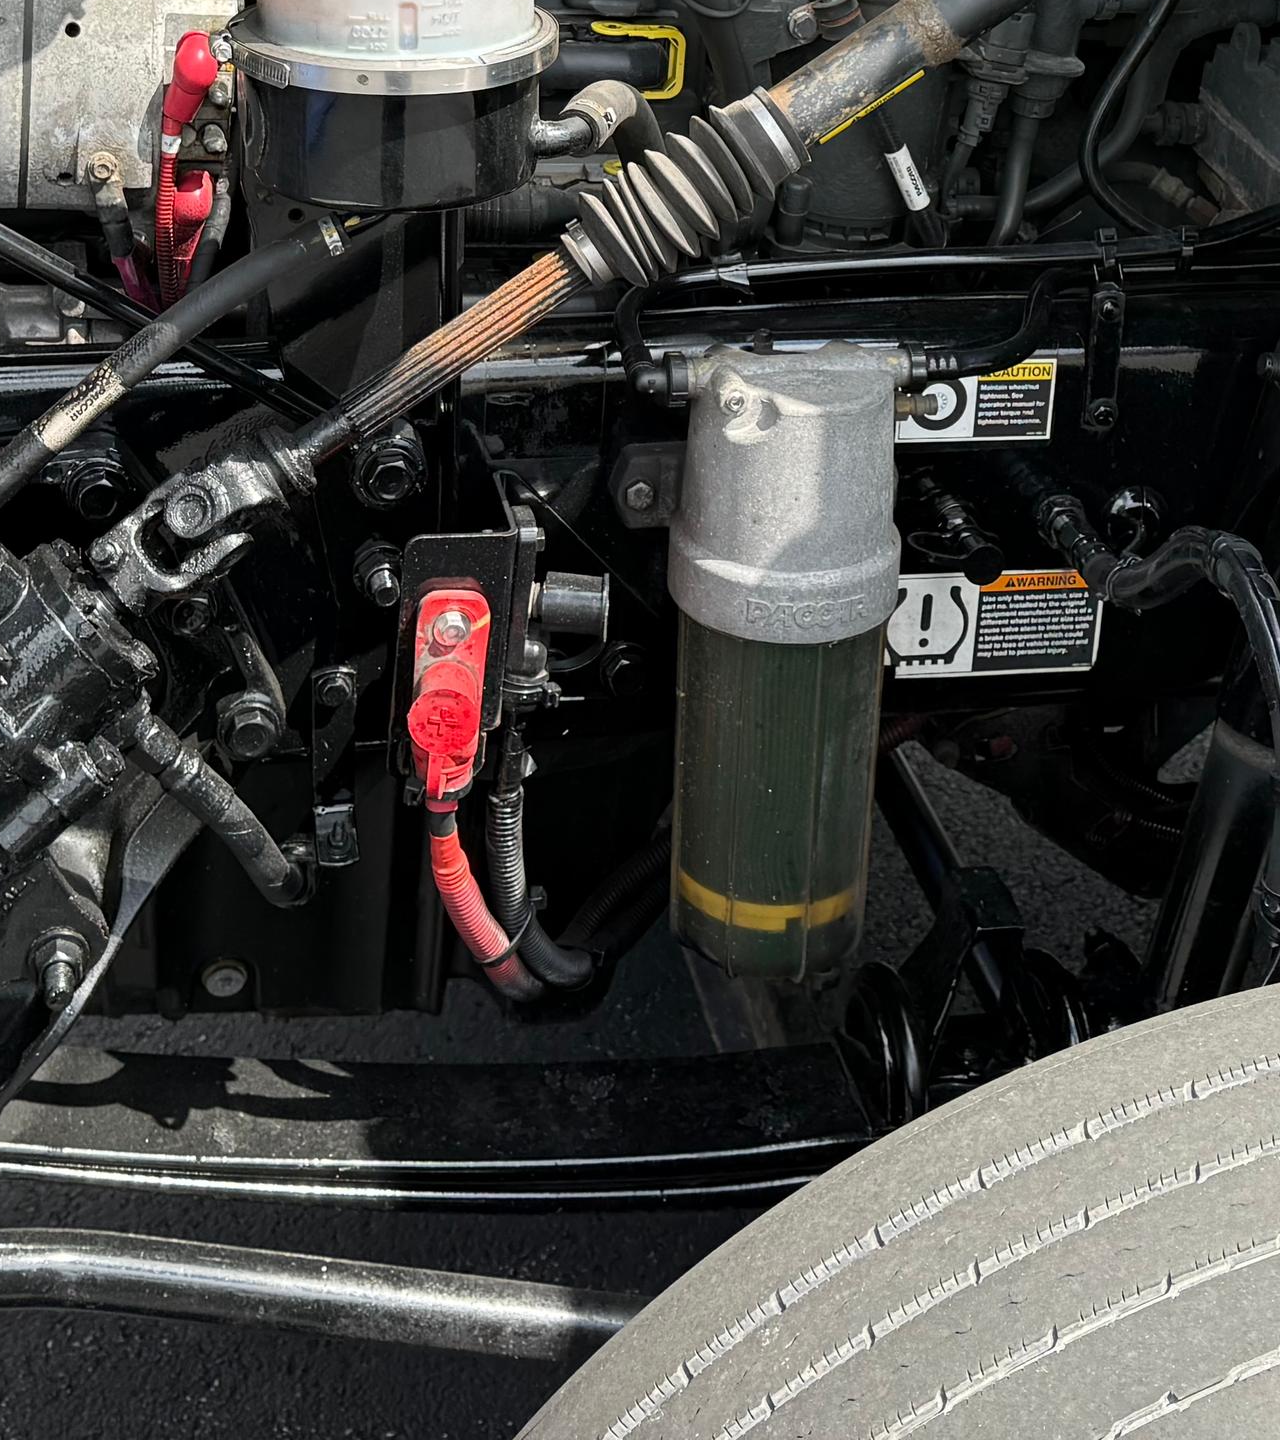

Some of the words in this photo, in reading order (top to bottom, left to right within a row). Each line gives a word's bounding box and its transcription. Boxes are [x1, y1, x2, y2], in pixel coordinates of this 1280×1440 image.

[992, 366, 1051, 377] CAUTION
[69, 386, 106, 422] PACCAR
[1015, 576, 1076, 586] WARNING
[746, 594, 869, 629] PACCAR
[1017, 648, 1046, 656] personal
